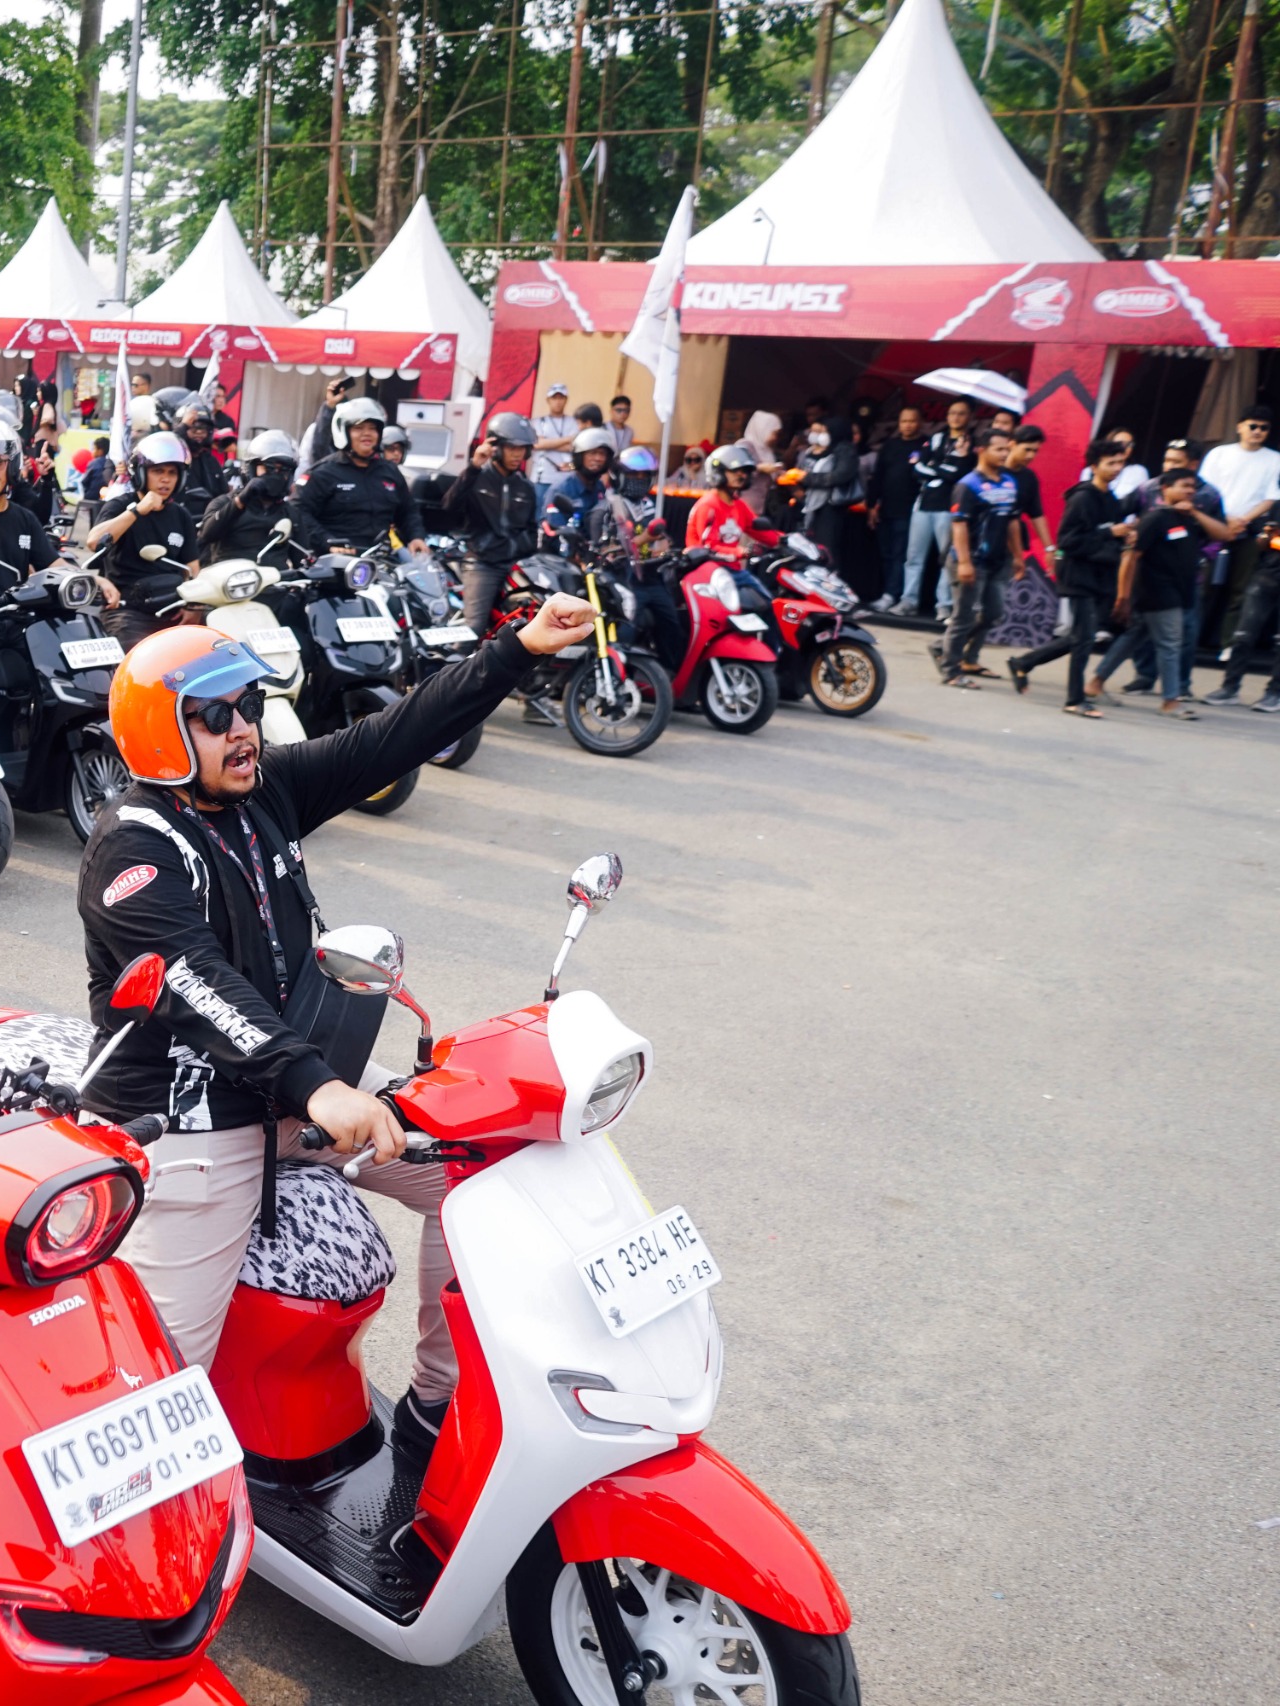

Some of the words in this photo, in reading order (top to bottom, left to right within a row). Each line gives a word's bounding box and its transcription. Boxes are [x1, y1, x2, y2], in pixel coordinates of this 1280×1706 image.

[680, 282, 848, 312] KONSUMSI
[114, 866, 150, 897] IMHS
[165, 955, 273, 1057] SAMARINDA
[583, 1257, 615, 1296] KT
[617, 1230, 669, 1278] 3384
[665, 1214, 697, 1251] HE
[28, 1294, 87, 1327] HONDA
[41, 1440, 86, 1490] KT
[86, 1405, 159, 1468] 6697
[157, 1381, 213, 1435] BBH
